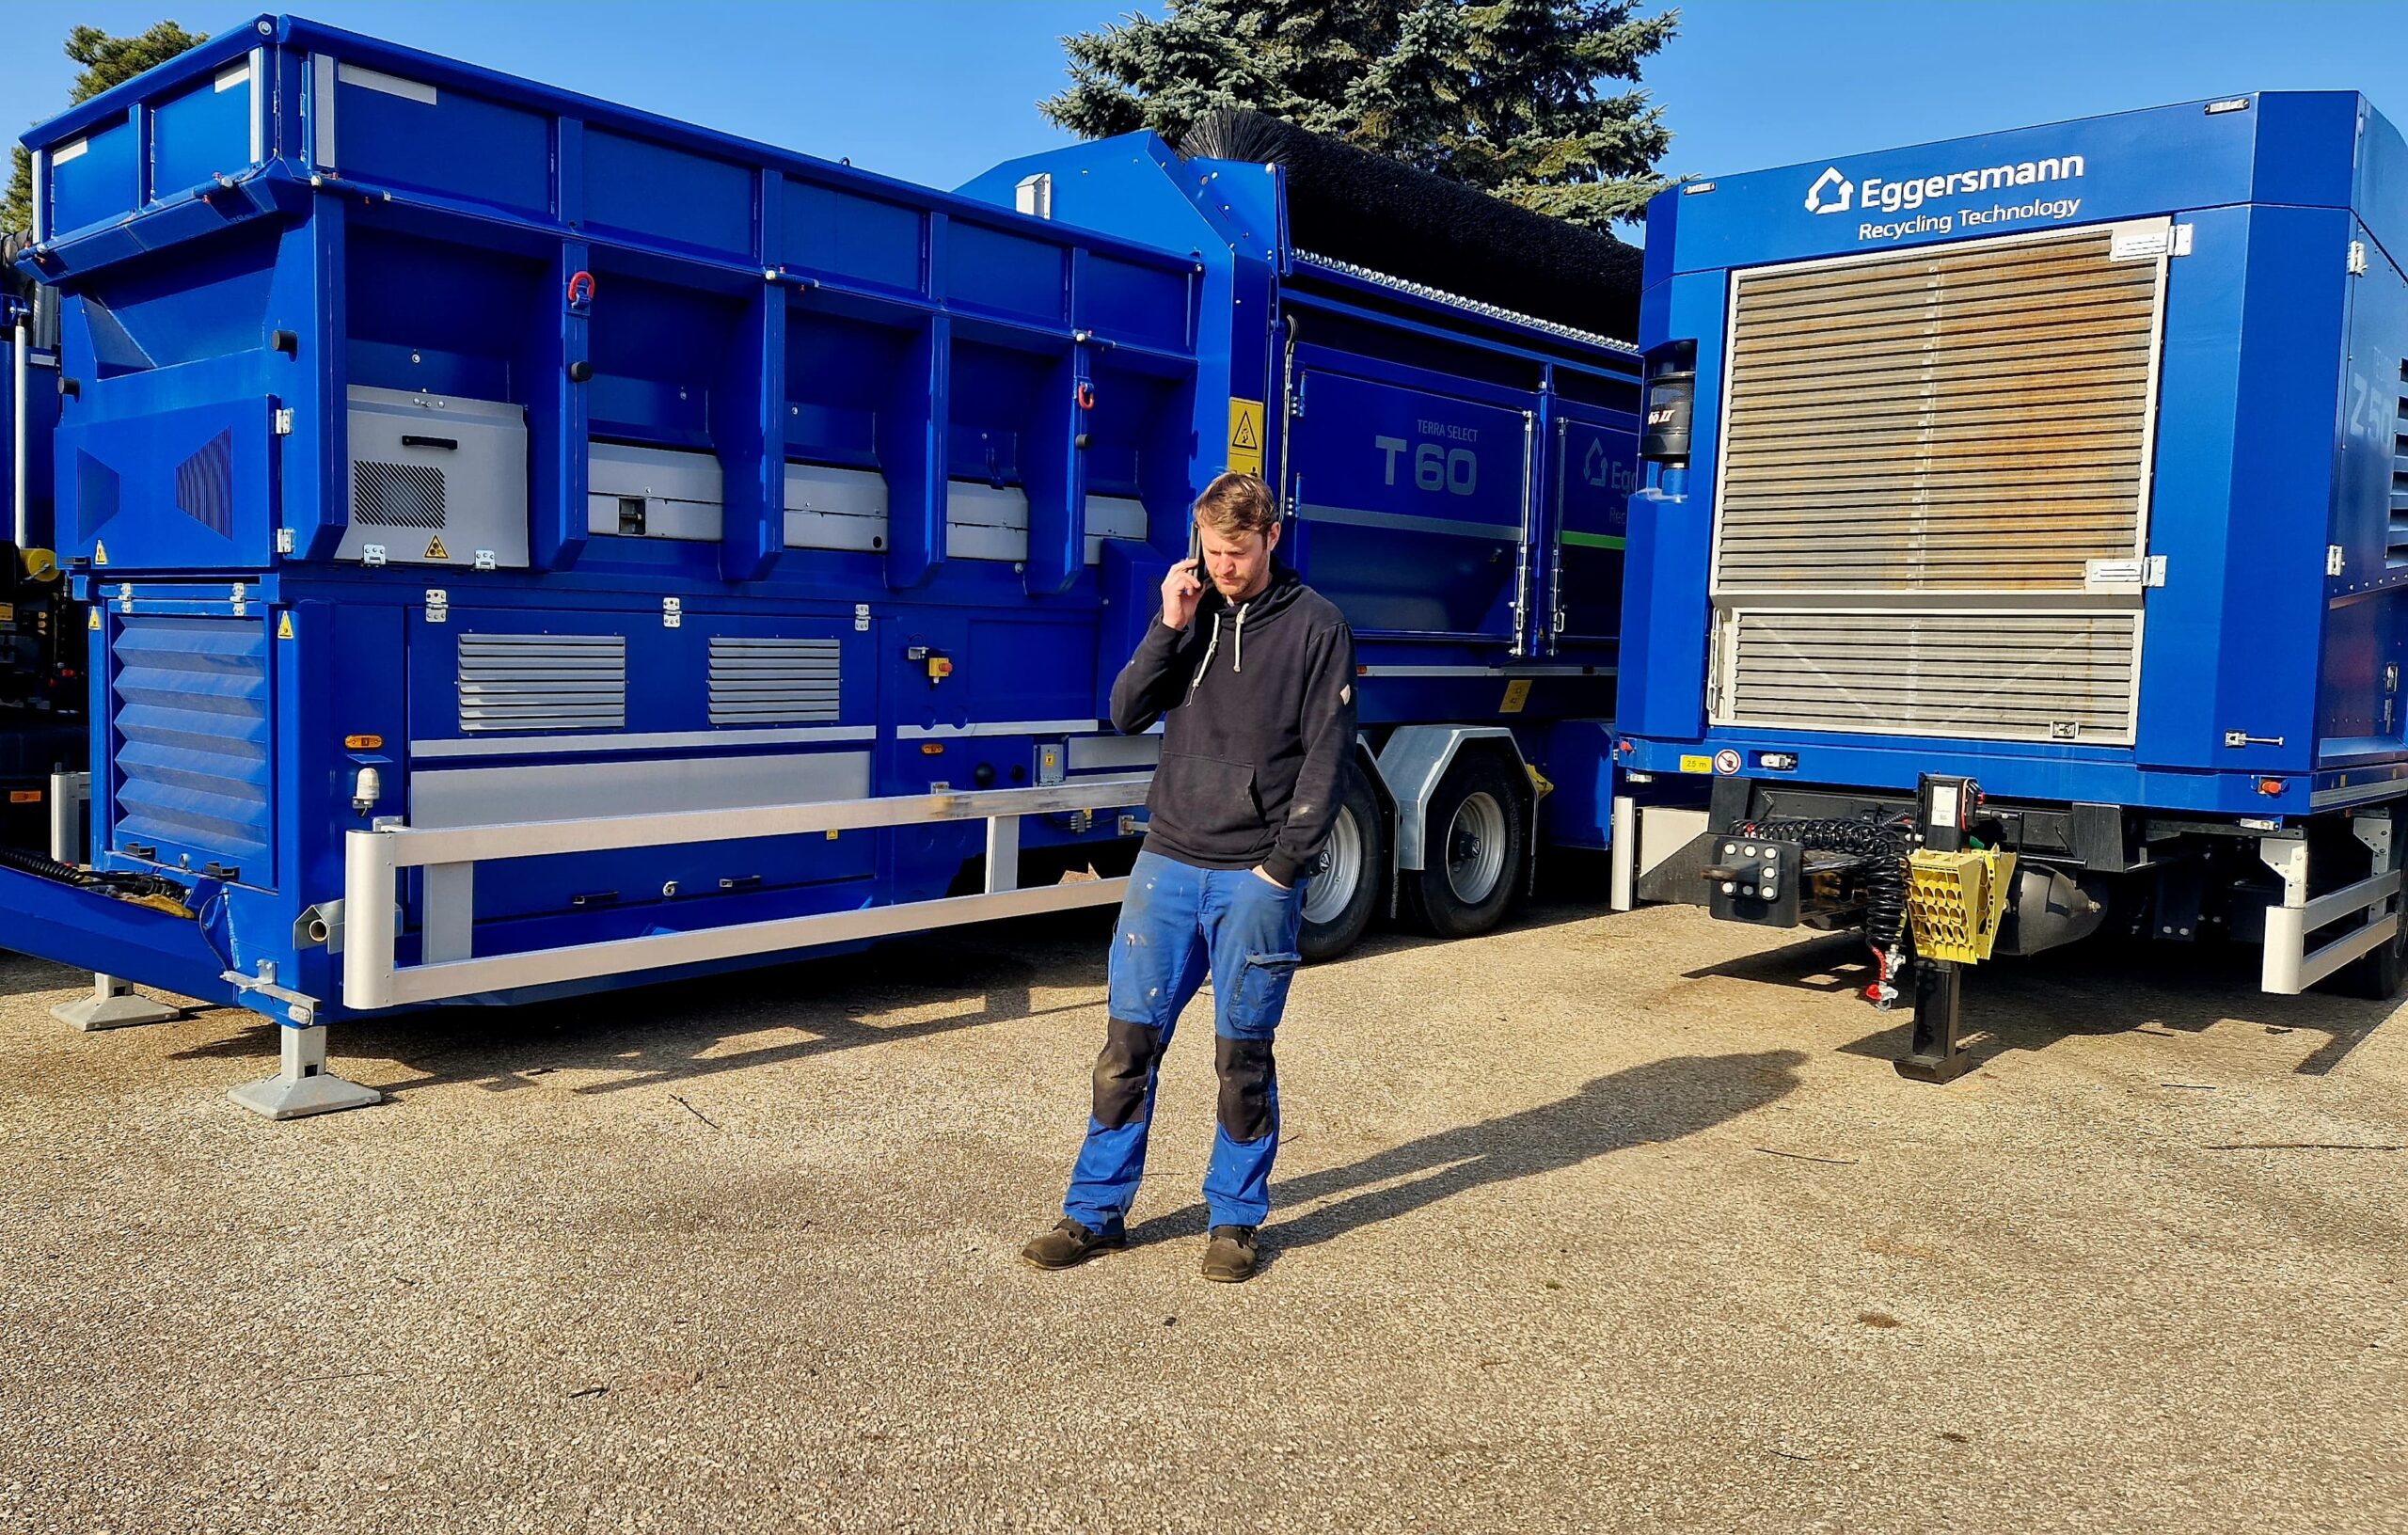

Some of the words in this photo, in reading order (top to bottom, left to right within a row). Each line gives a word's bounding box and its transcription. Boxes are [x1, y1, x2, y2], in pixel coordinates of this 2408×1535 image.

[1861, 155, 2083, 212] Eggersmann
[1859, 214, 1952, 241] Recycling
[1958, 198, 2081, 226] Technology
[1418, 419, 1445, 436] TERRA
[1448, 425, 1478, 442] SELECT
[1375, 435, 1407, 485] T
[1416, 443, 1477, 496] 60
